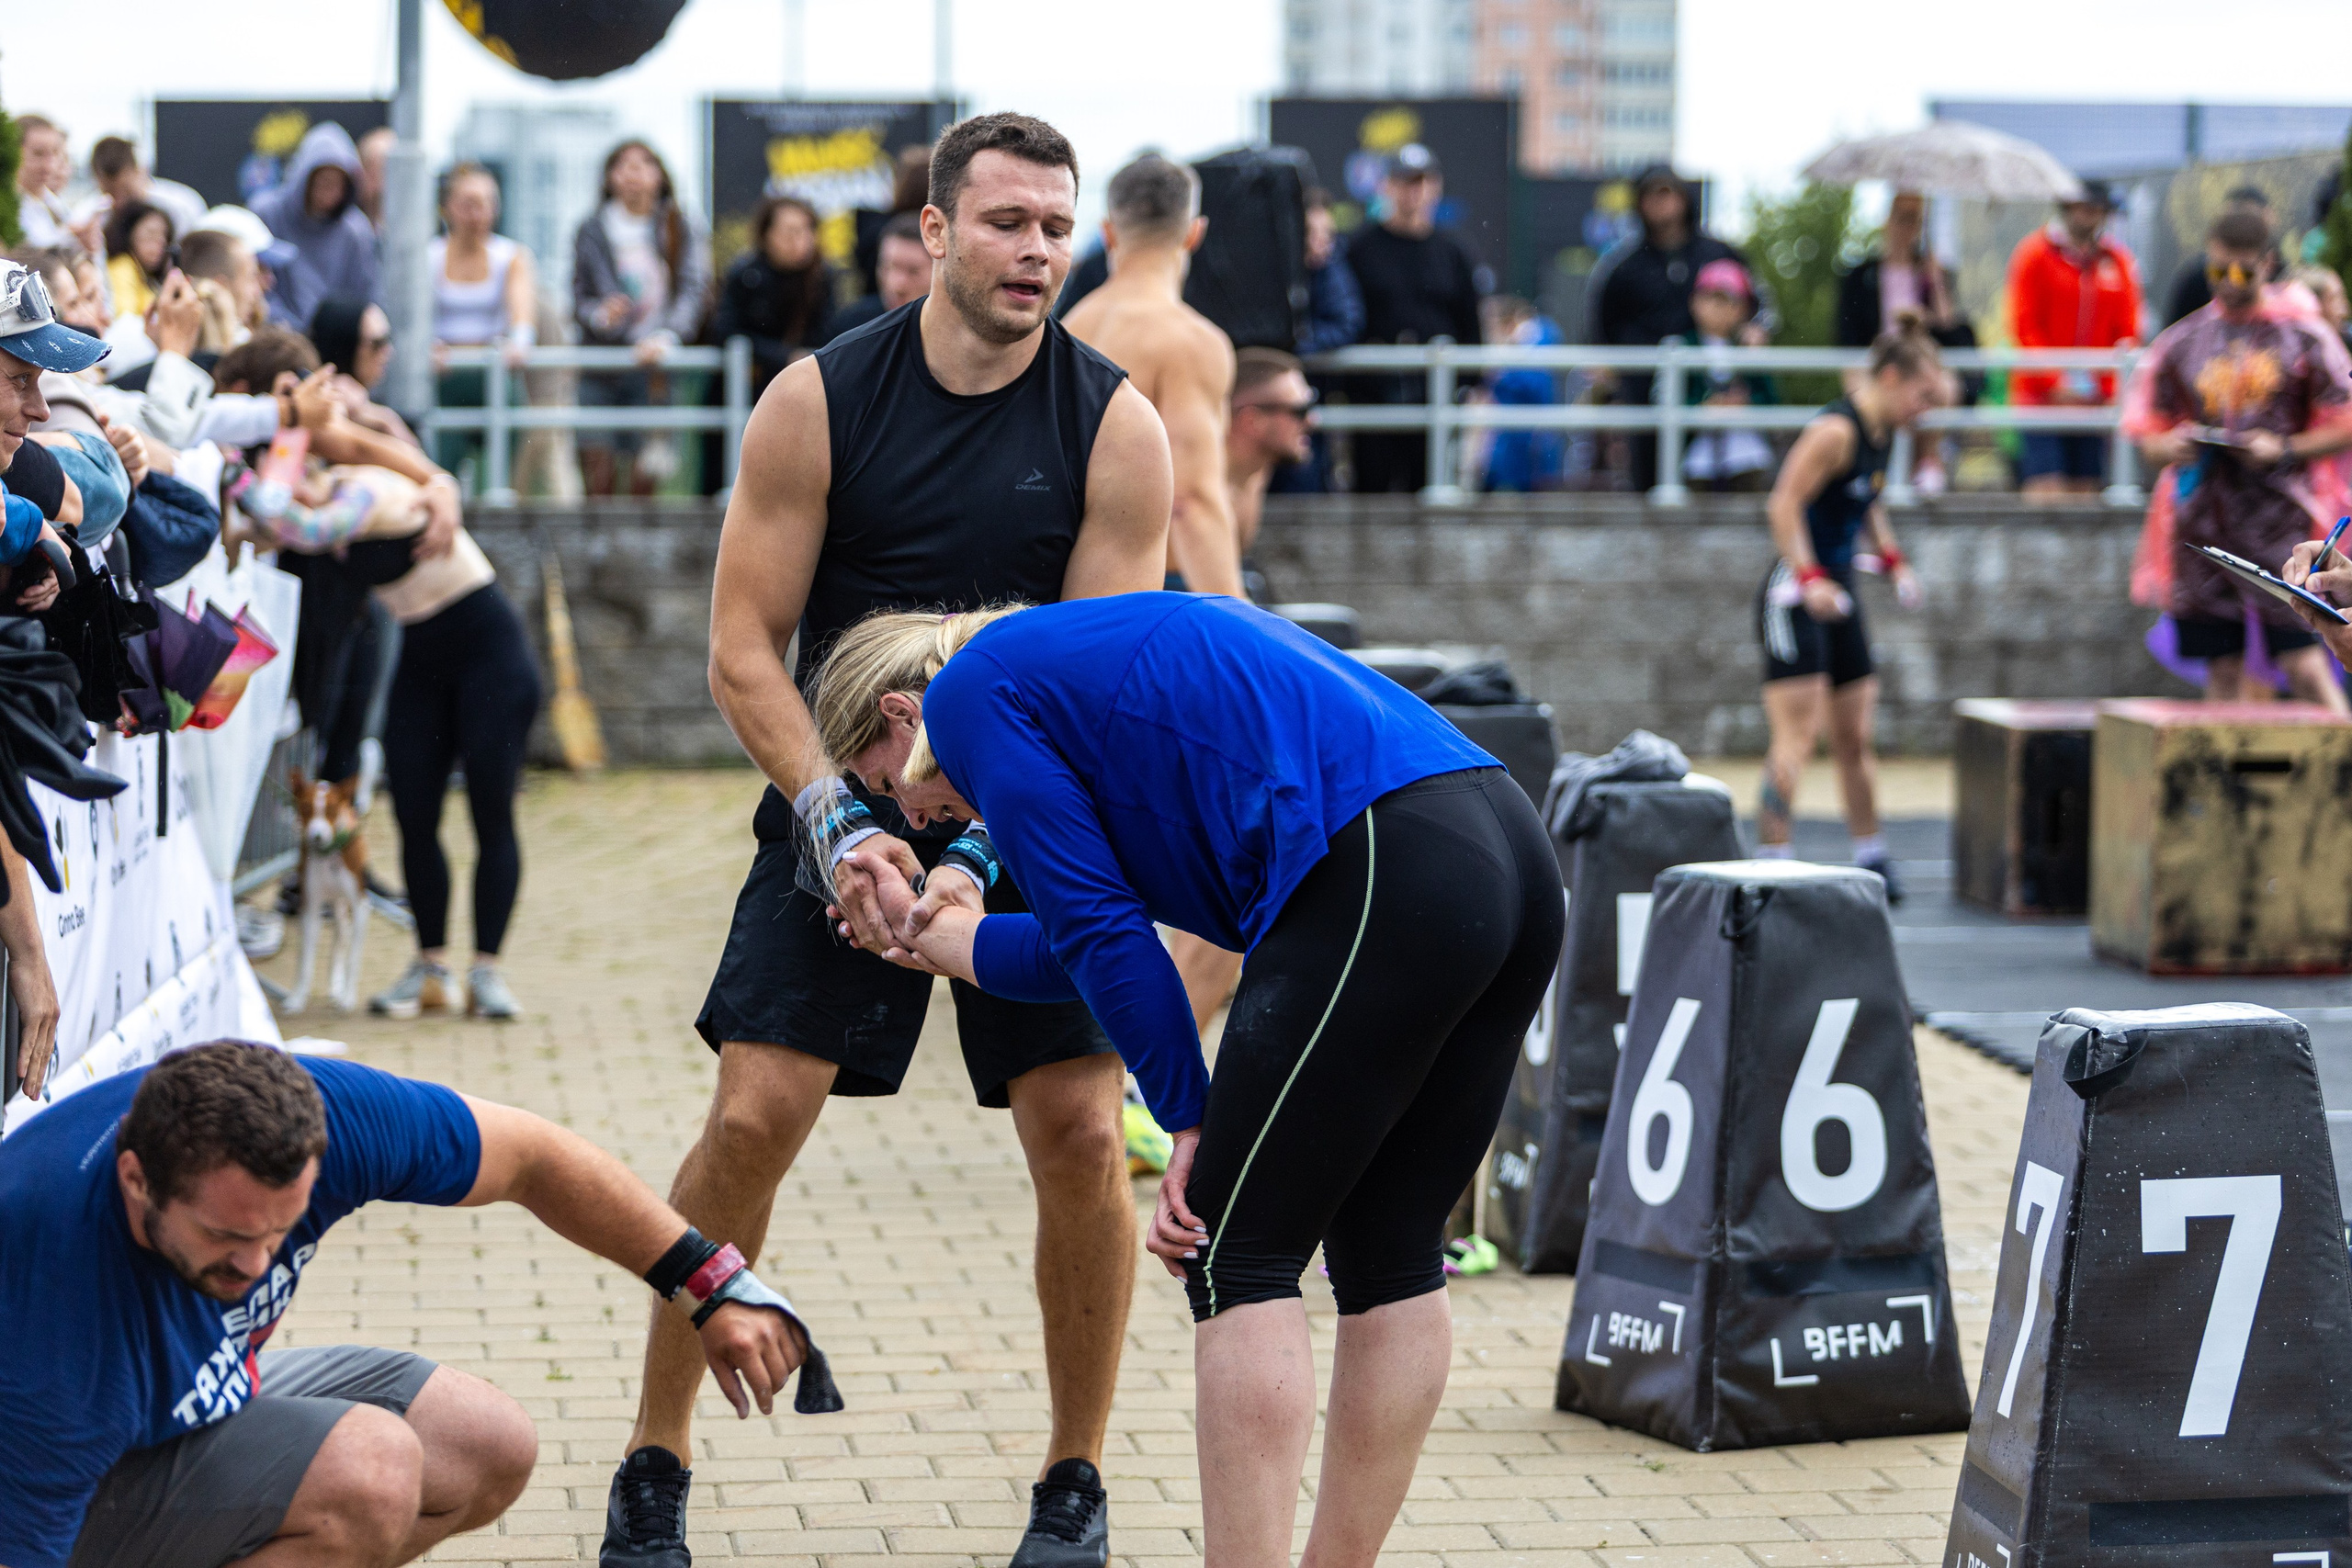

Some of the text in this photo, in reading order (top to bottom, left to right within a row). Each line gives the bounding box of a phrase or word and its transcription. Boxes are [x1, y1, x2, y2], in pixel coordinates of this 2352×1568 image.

[1627, 997, 1702, 1206] 6
[1781, 998, 1887, 1212] 6
[1608, 1311, 1664, 1354] BFFM
[1804, 1320, 1904, 1361] BFFM
[1997, 1161, 2064, 1418] 7
[2141, 1175, 2282, 1437] 7
